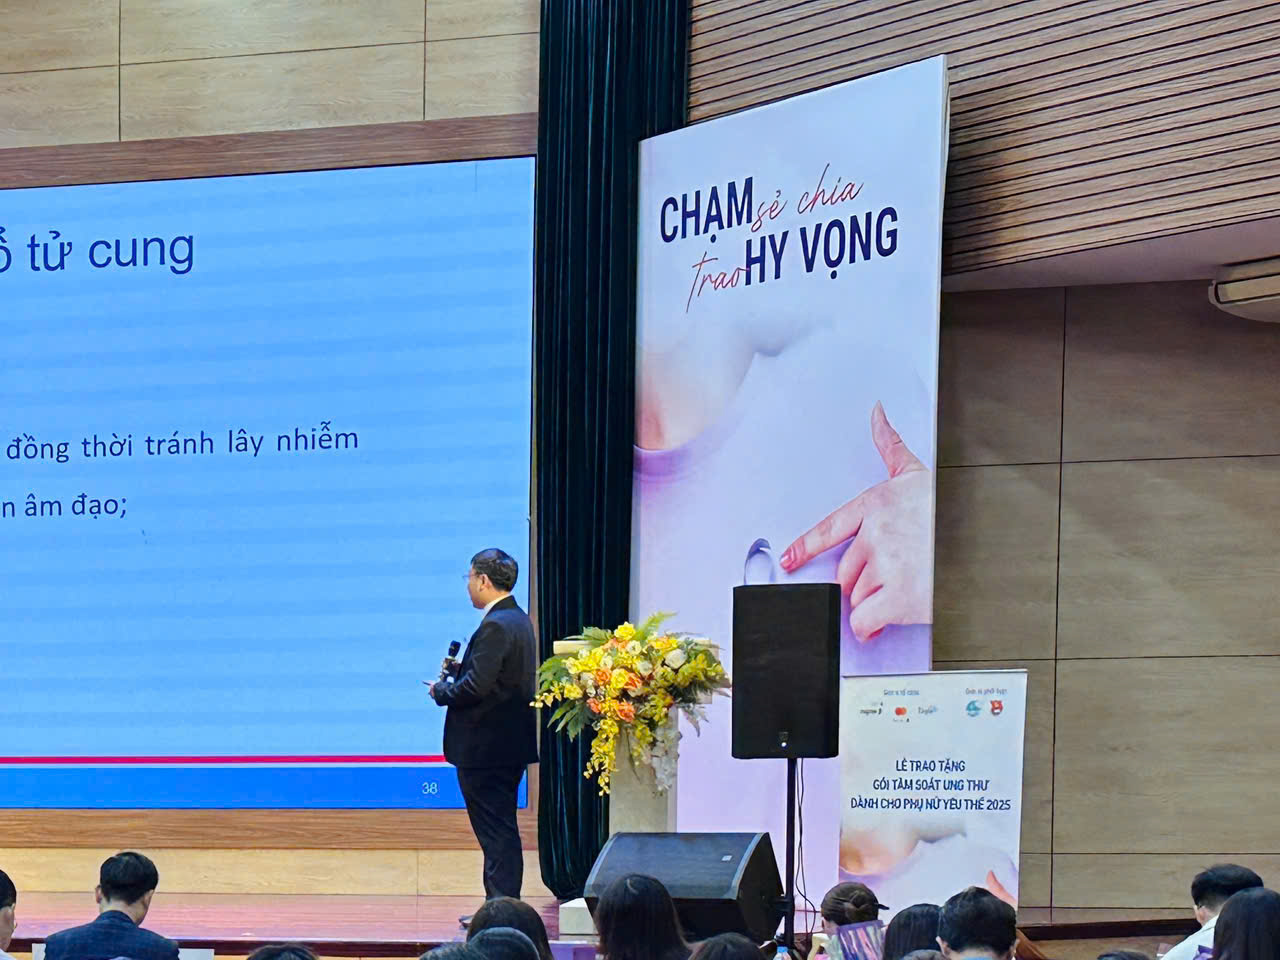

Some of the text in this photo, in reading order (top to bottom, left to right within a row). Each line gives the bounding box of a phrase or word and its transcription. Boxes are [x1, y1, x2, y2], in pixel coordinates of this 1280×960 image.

[660, 176, 753, 244] CHẠM
[797, 163, 864, 215] chia
[26, 230, 73, 272] tử
[88, 234, 194, 275] cung
[745, 231, 789, 286] HY
[800, 206, 898, 280] VỌNG
[6, 432, 70, 464] đồng
[81, 432, 133, 458] thời
[144, 430, 214, 456] tránh
[228, 428, 264, 458] lây
[277, 420, 358, 452] nhiễm
[24, 492, 62, 517] âm
[71, 492, 127, 520] đạo;
[910, 760, 936, 772] TRAO
[422, 782, 438, 794] 38
[873, 776, 889, 791] GÓI
[915, 777, 941, 791] SOÁT
[880, 798, 901, 809] CHO
[986, 799, 1011, 811] 2025
